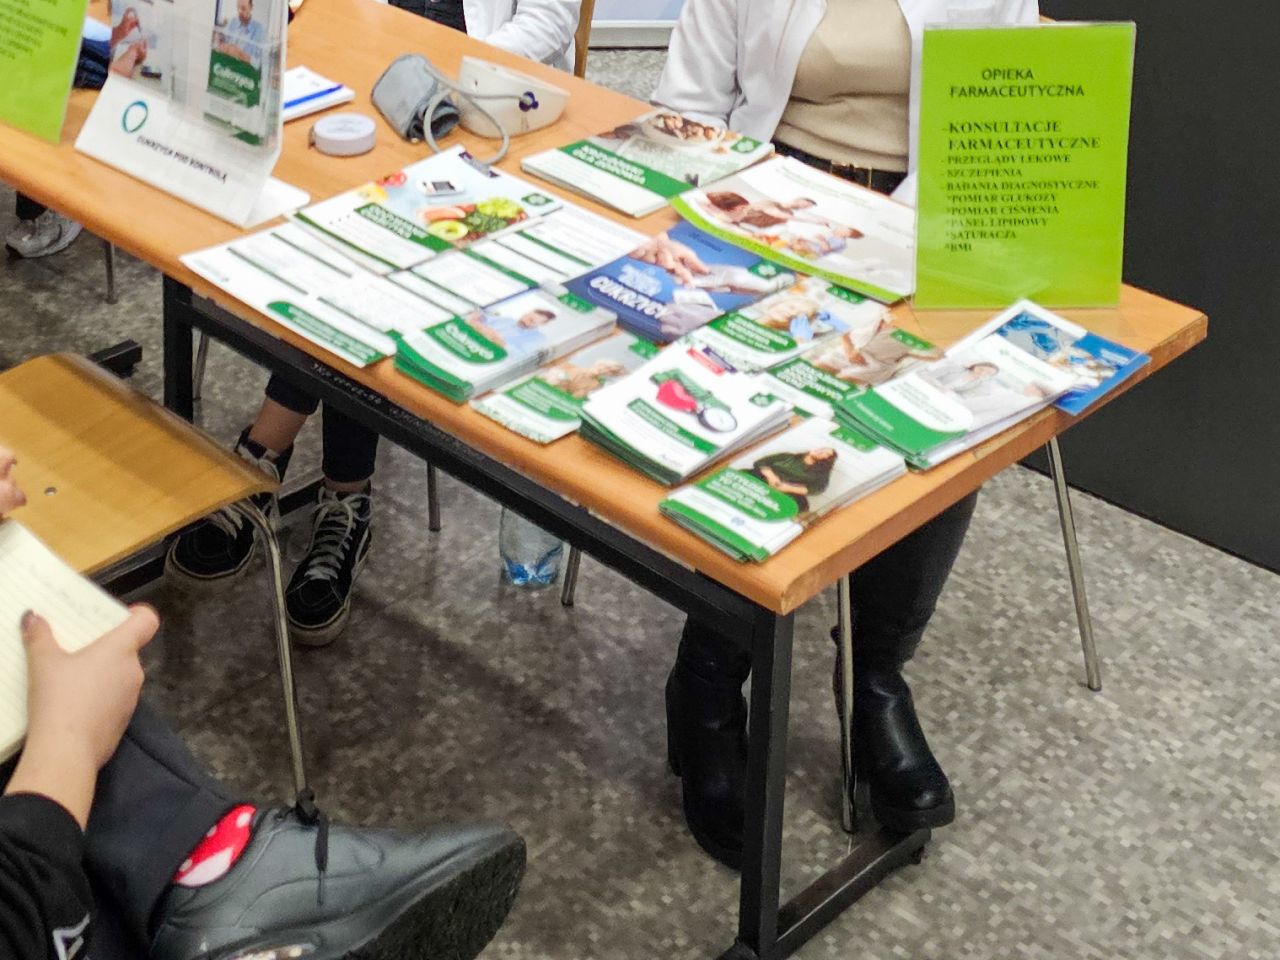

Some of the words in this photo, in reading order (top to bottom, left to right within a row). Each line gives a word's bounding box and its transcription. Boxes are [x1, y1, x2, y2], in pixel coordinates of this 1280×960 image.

[981, 68, 1034, 80] OPIEKA
[949, 84, 1085, 98] FARMACEUTYCZNA
[948, 136, 1100, 150] FARMACEUTYCZNE
[1021, 154, 1071, 163] LEKOWE
[1001, 180, 1098, 190] DIAGNOSTYCZNE
[1001, 193, 1056, 202] GLUKOZY
[990, 217, 1048, 226] LIPIDOWY
